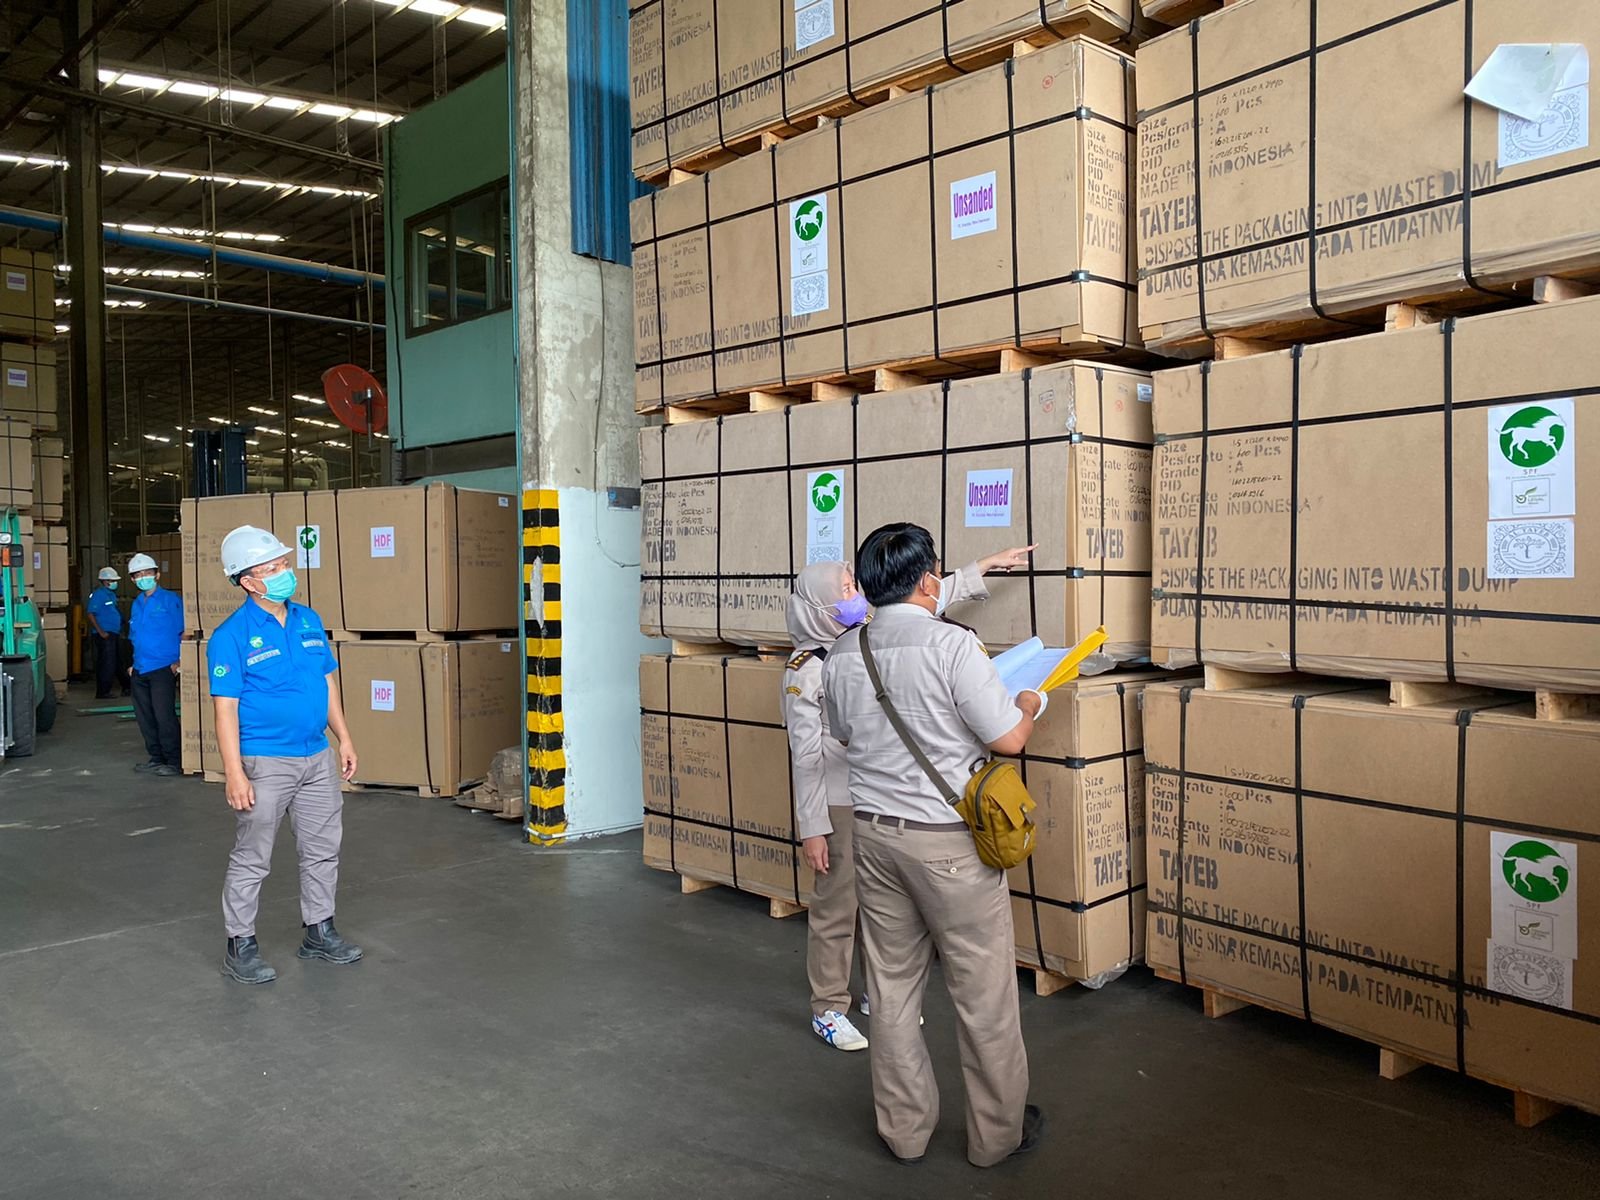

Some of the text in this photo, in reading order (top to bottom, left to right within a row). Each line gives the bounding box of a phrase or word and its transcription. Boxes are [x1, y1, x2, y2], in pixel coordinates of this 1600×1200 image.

[668, 21, 712, 50] INDONESIA
[729, 63, 750, 87] INTO
[751, 49, 781, 77] WASTE
[722, 91, 744, 114] PADA
[1236, 95, 1263, 113] Pcs
[1141, 116, 1168, 133] Size
[1087, 127, 1106, 143] Size
[1141, 119, 1226, 160] Grade A
[1087, 152, 1114, 172] Grade
[1141, 155, 1163, 172] PID
[1087, 165, 1104, 181] PID
[1140, 175, 1179, 200] MADE
[1209, 142, 1294, 178] INDONESIA
[1140, 172, 1158, 185] No
[1087, 178, 1101, 192] No
[953, 183, 993, 219] Unsanded
[1087, 191, 1114, 213] MADE
[1139, 194, 1197, 240] TAYEB
[1145, 233, 1198, 267] DISPOSE
[1203, 226, 1230, 253] THE
[1328, 192, 1368, 226] INTO
[1374, 174, 1436, 213] WASTE
[1146, 267, 1193, 297] BUANG
[1230, 240, 1305, 279] KEMASAN
[670, 337, 683, 355] THE
[731, 322, 750, 345] INTO
[1161, 441, 1187, 454] Size
[1254, 444, 1281, 457] Pcs
[1161, 460, 1244, 480] Grade A
[969, 480, 1009, 507] Unsanded
[1081, 481, 1096, 493] PID
[1160, 480, 1182, 492] PID
[1081, 494, 1094, 505] No
[1159, 492, 1176, 505] No
[1112, 509, 1120, 521] IN
[1158, 503, 1197, 520] MADE
[676, 526, 718, 537] INDONESIA
[374, 534, 391, 547] HDF
[1160, 567, 1215, 590] DISPOSE
[1219, 567, 1245, 588] THE
[1343, 567, 1384, 591] INTO
[724, 593, 744, 609] PADA
[1160, 598, 1207, 618] BUANG
[1211, 600, 1241, 620] SISA
[375, 687, 392, 700] HDF
[680, 764, 721, 779] INDONESIA
[1085, 776, 1104, 788] Size
[1246, 788, 1273, 804] Pcs
[1086, 798, 1113, 814] Grade
[1152, 799, 1173, 812] PID
[1226, 799, 1236, 812] A
[1087, 813, 1102, 826] PID
[1152, 811, 1169, 824] No
[1087, 827, 1099, 840] No
[1101, 821, 1125, 835] Crate
[691, 831, 729, 854] KEMASAN
[1087, 835, 1112, 853] MADE
[1117, 831, 1125, 843] IN
[1197, 833, 1210, 848] IN
[1159, 848, 1219, 890] TAYEB
[1213, 903, 1238, 926] THE
[1207, 931, 1238, 961] SISA
[1318, 963, 1361, 998] PADA
